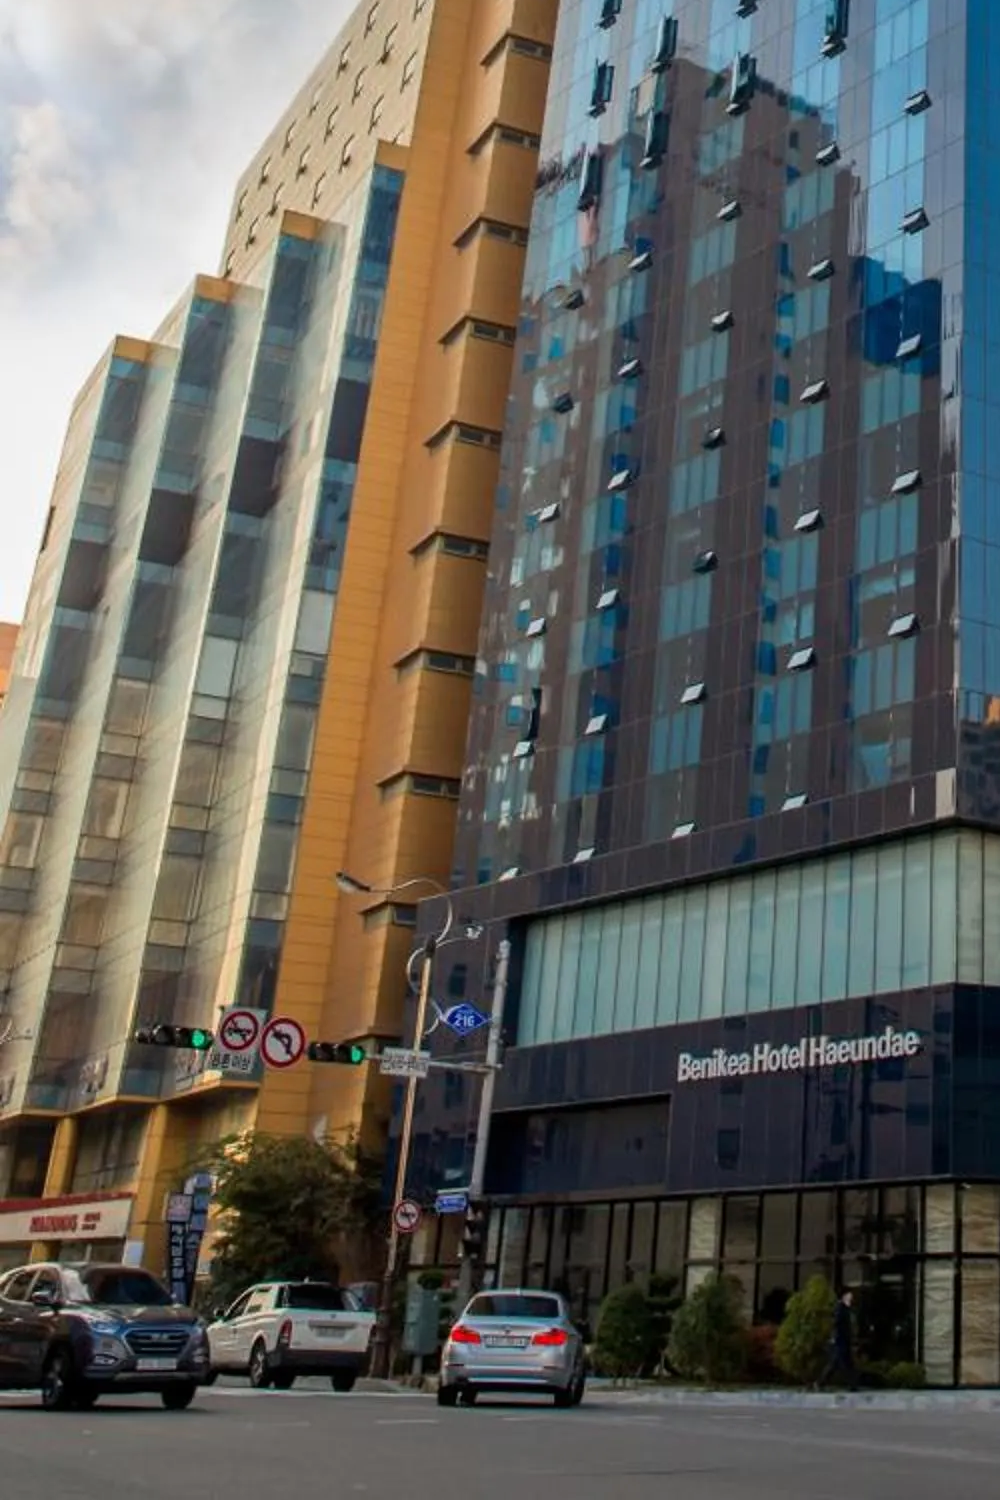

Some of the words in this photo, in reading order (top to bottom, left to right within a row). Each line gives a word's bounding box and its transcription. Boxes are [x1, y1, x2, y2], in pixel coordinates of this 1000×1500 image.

[677, 1046, 750, 1082] Benikea
[751, 1037, 806, 1074] Hotel
[809, 1025, 921, 1067] Haeundae
